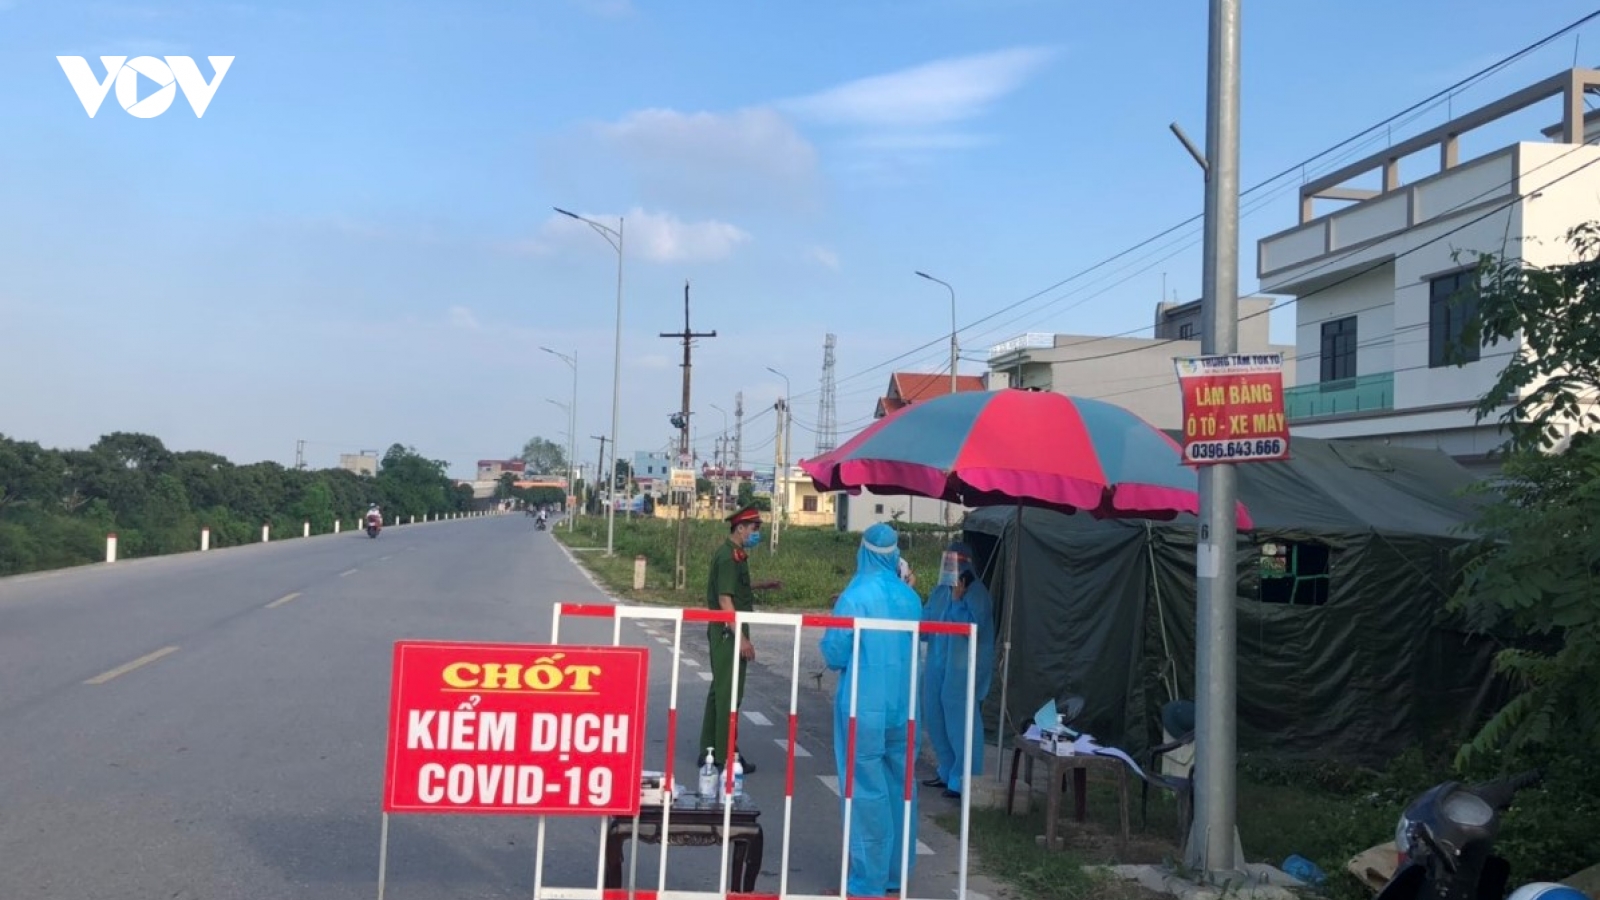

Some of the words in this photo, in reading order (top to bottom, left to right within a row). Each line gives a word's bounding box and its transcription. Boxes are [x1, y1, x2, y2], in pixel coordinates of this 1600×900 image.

[1195, 381, 1225, 407] LÀM
[1228, 376, 1273, 405] BẰNG
[1187, 412, 1197, 437] Ô
[1200, 412, 1217, 437] TÔ
[1229, 415, 1249, 435] XE
[1252, 408, 1285, 434] MÁY
[1192, 439, 1281, 459] 0396.643.666
[442, 652, 602, 691] CHỐT
[406, 694, 518, 752] KIỂM
[530, 711, 630, 762] DỊCH
[417, 762, 613, 807] COVID-19
